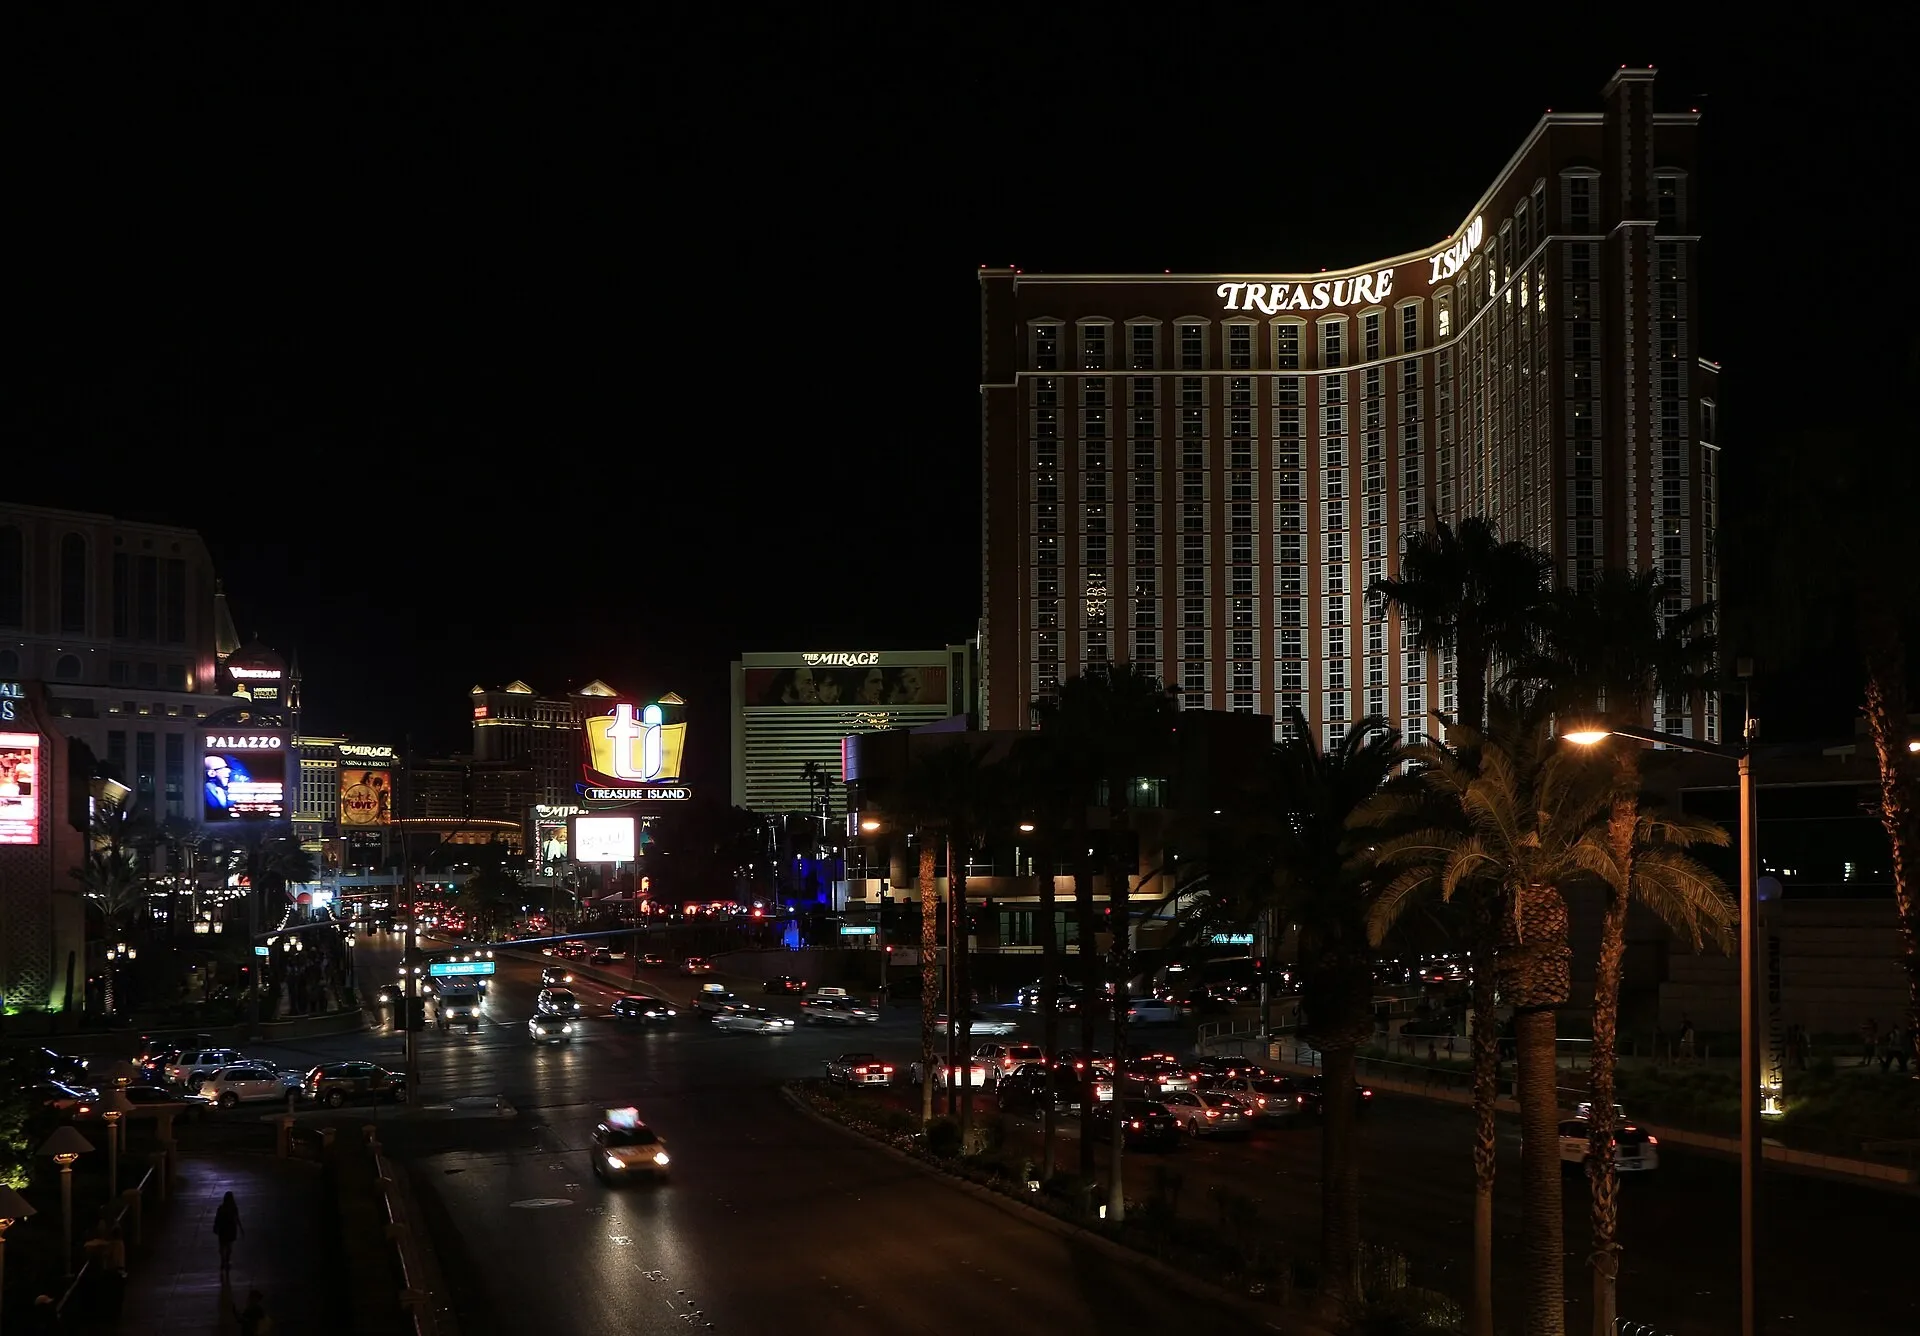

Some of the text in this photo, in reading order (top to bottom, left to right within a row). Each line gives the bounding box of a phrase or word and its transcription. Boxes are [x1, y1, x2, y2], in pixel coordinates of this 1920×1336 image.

[1217, 215, 1483, 315] TREASURE ISLAND
[803, 653, 879, 667] THE MIRAGE
[205, 735, 281, 749] PALAZZO
[342, 745, 392, 757] MIRAGE
[592, 789, 685, 799] TREASURE ISLAND
[351, 801, 373, 810] LOVE
[445, 964, 475, 974] SANDS
